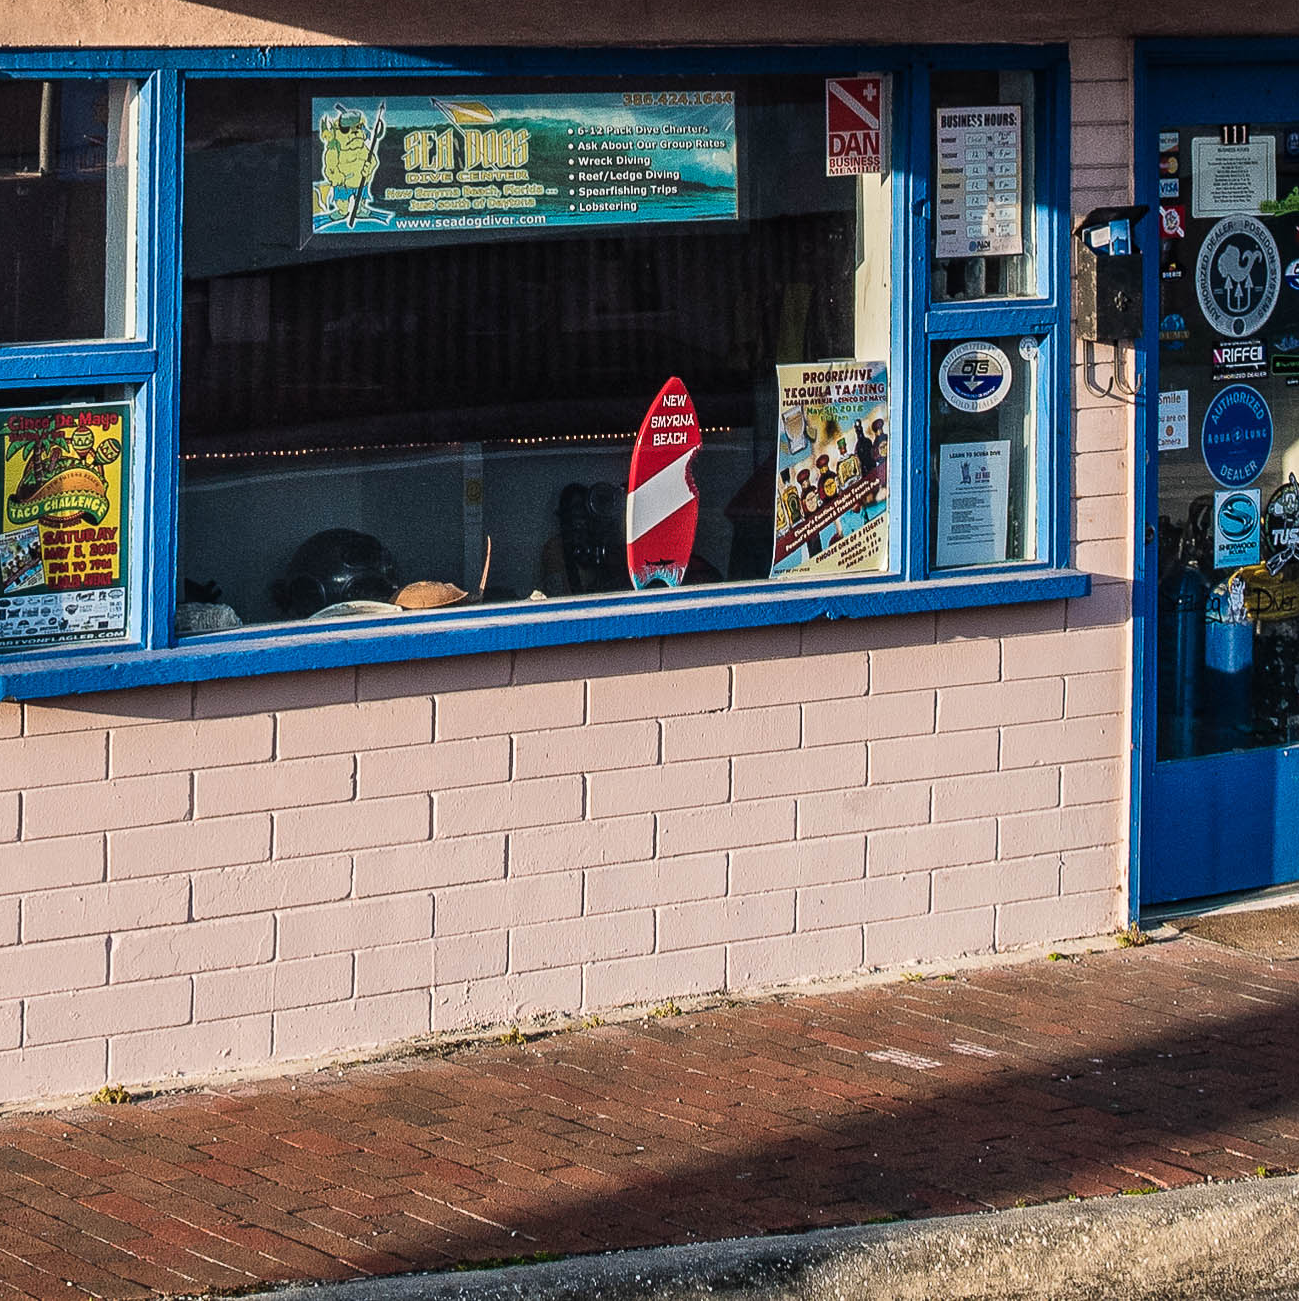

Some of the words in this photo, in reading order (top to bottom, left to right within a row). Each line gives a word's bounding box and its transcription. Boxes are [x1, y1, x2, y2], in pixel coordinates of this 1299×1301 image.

[622, 92, 734, 107] 386.424.1644
[941, 114, 983, 128] BUSINESS
[984, 113, 1017, 127] HOURS:
[577, 126, 603, 136] 6-12
[605, 126, 632, 135] Pack
[635, 125, 660, 135] Dive
[663, 124, 709, 134] Charters
[1223, 125, 1247, 145] 111
[401, 129, 454, 171] SEA
[464, 129, 531, 171] DOGS
[577, 141, 598, 151] Ask
[600, 140, 633, 150] About
[636, 140, 657, 149] Our
[660, 139, 692, 150] Group
[695, 138, 726, 148] Rates
[829, 132, 880, 157] DAN
[578, 157, 613, 166] Wreck
[616, 156, 651, 166] Diving
[829, 156, 880, 168] BUSINESS
[405, 172, 453, 184] DIVE
[456, 170, 530, 182] CENTER
[578, 171, 643, 182] Reef/Ledge
[645, 170, 680, 181] Diving
[829, 165, 880, 175] MEMBER
[578, 186, 647, 198] Spearfishing
[650, 185, 678, 196] Trips
[1160, 181, 1179, 193] VISA
[579, 201, 638, 212] Lobstering
[395, 215, 546, 229] www.seadogdiver.com
[1207, 221, 1234, 251] DEALER
[1244, 220, 1277, 265] POSEIDON
[1200, 254, 1221, 321] AUTHORIZED
[802, 369, 873, 385] PROGRESSIVE
[783, 385, 832, 399] TEQUILA
[834, 383, 885, 396] TASTING
[662, 394, 688, 408] NEW
[1211, 391, 1265, 425] AUTHORIZED
[7, 413, 50, 432] Cinco
[55, 412, 74, 429] De
[78, 410, 119, 432] Mayo
[651, 413, 695, 429] SMYRNA
[653, 432, 688, 446] BEACH
[1208, 433, 1231, 445] AQUA
[1244, 429, 1267, 440] LUNG
[1220, 460, 1259, 481] DEALER
[10, 505, 40, 519] TACO
[43, 494, 107, 516] CHALLENGE
[1218, 541, 1257, 552] SHERWOOD
